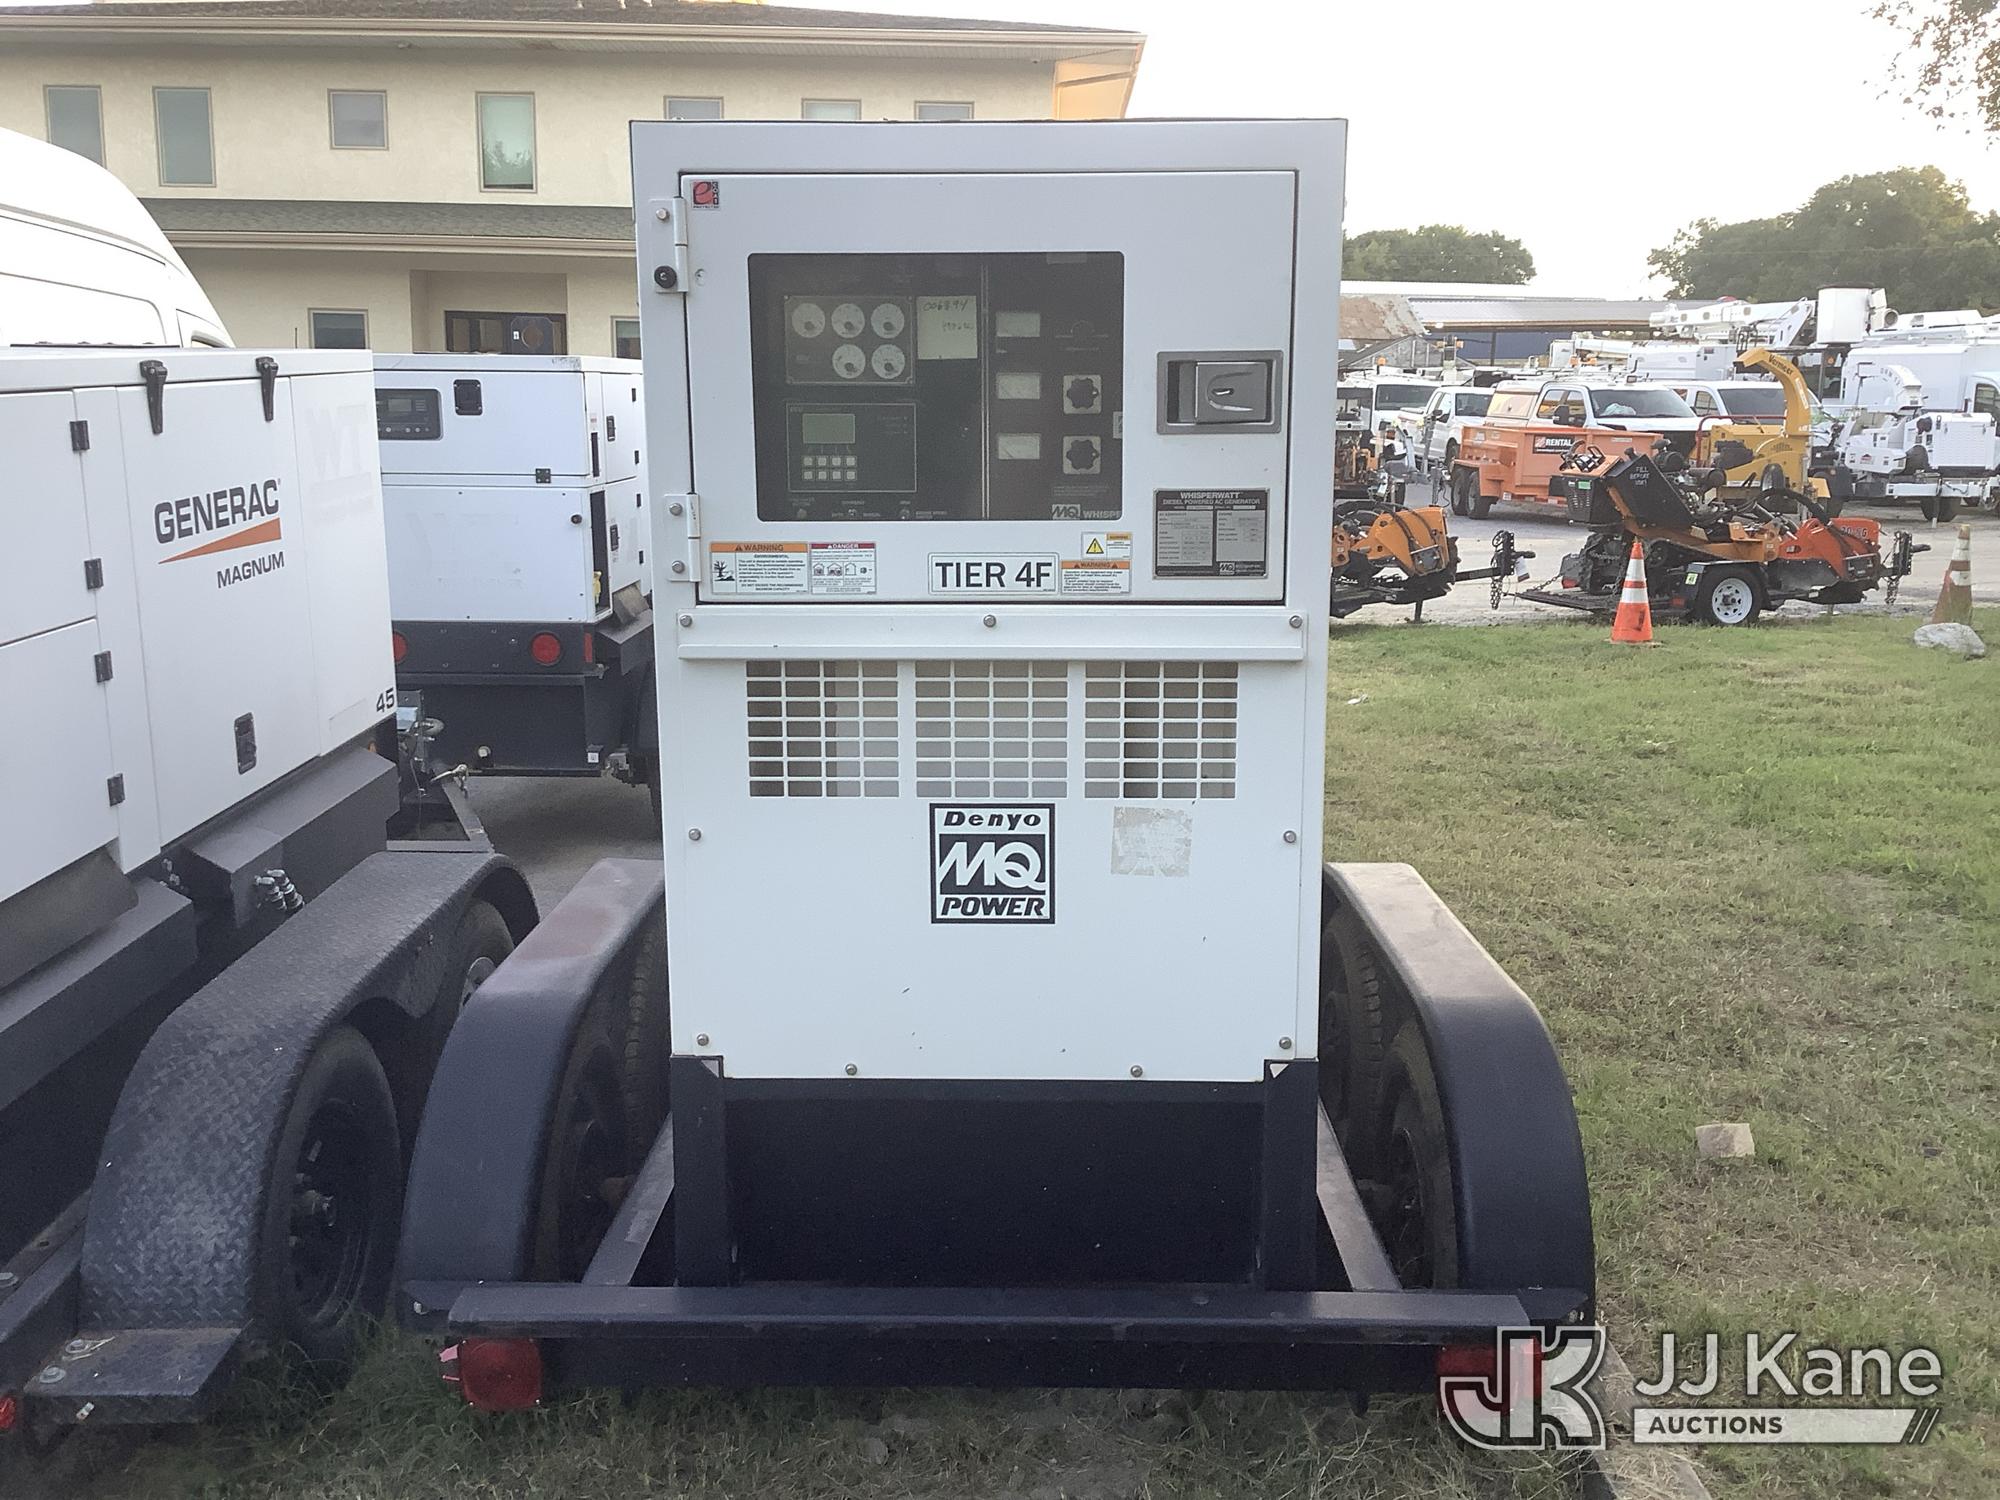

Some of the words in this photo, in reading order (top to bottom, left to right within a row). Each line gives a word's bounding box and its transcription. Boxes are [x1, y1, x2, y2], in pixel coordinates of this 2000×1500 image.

[1768, 354, 1794, 376] Vermeer
[1545, 438, 1573, 447] RENTAL
[154, 479, 280, 544] GENERAC
[216, 551, 285, 589] MAGNUM
[935, 562, 1005, 588] TIER
[1015, 561, 1052, 588] 4F
[376, 687, 395, 712] 45
[943, 810, 1041, 831] Denyo
[939, 841, 1046, 891] MQ
[941, 896, 1045, 917] POWER
